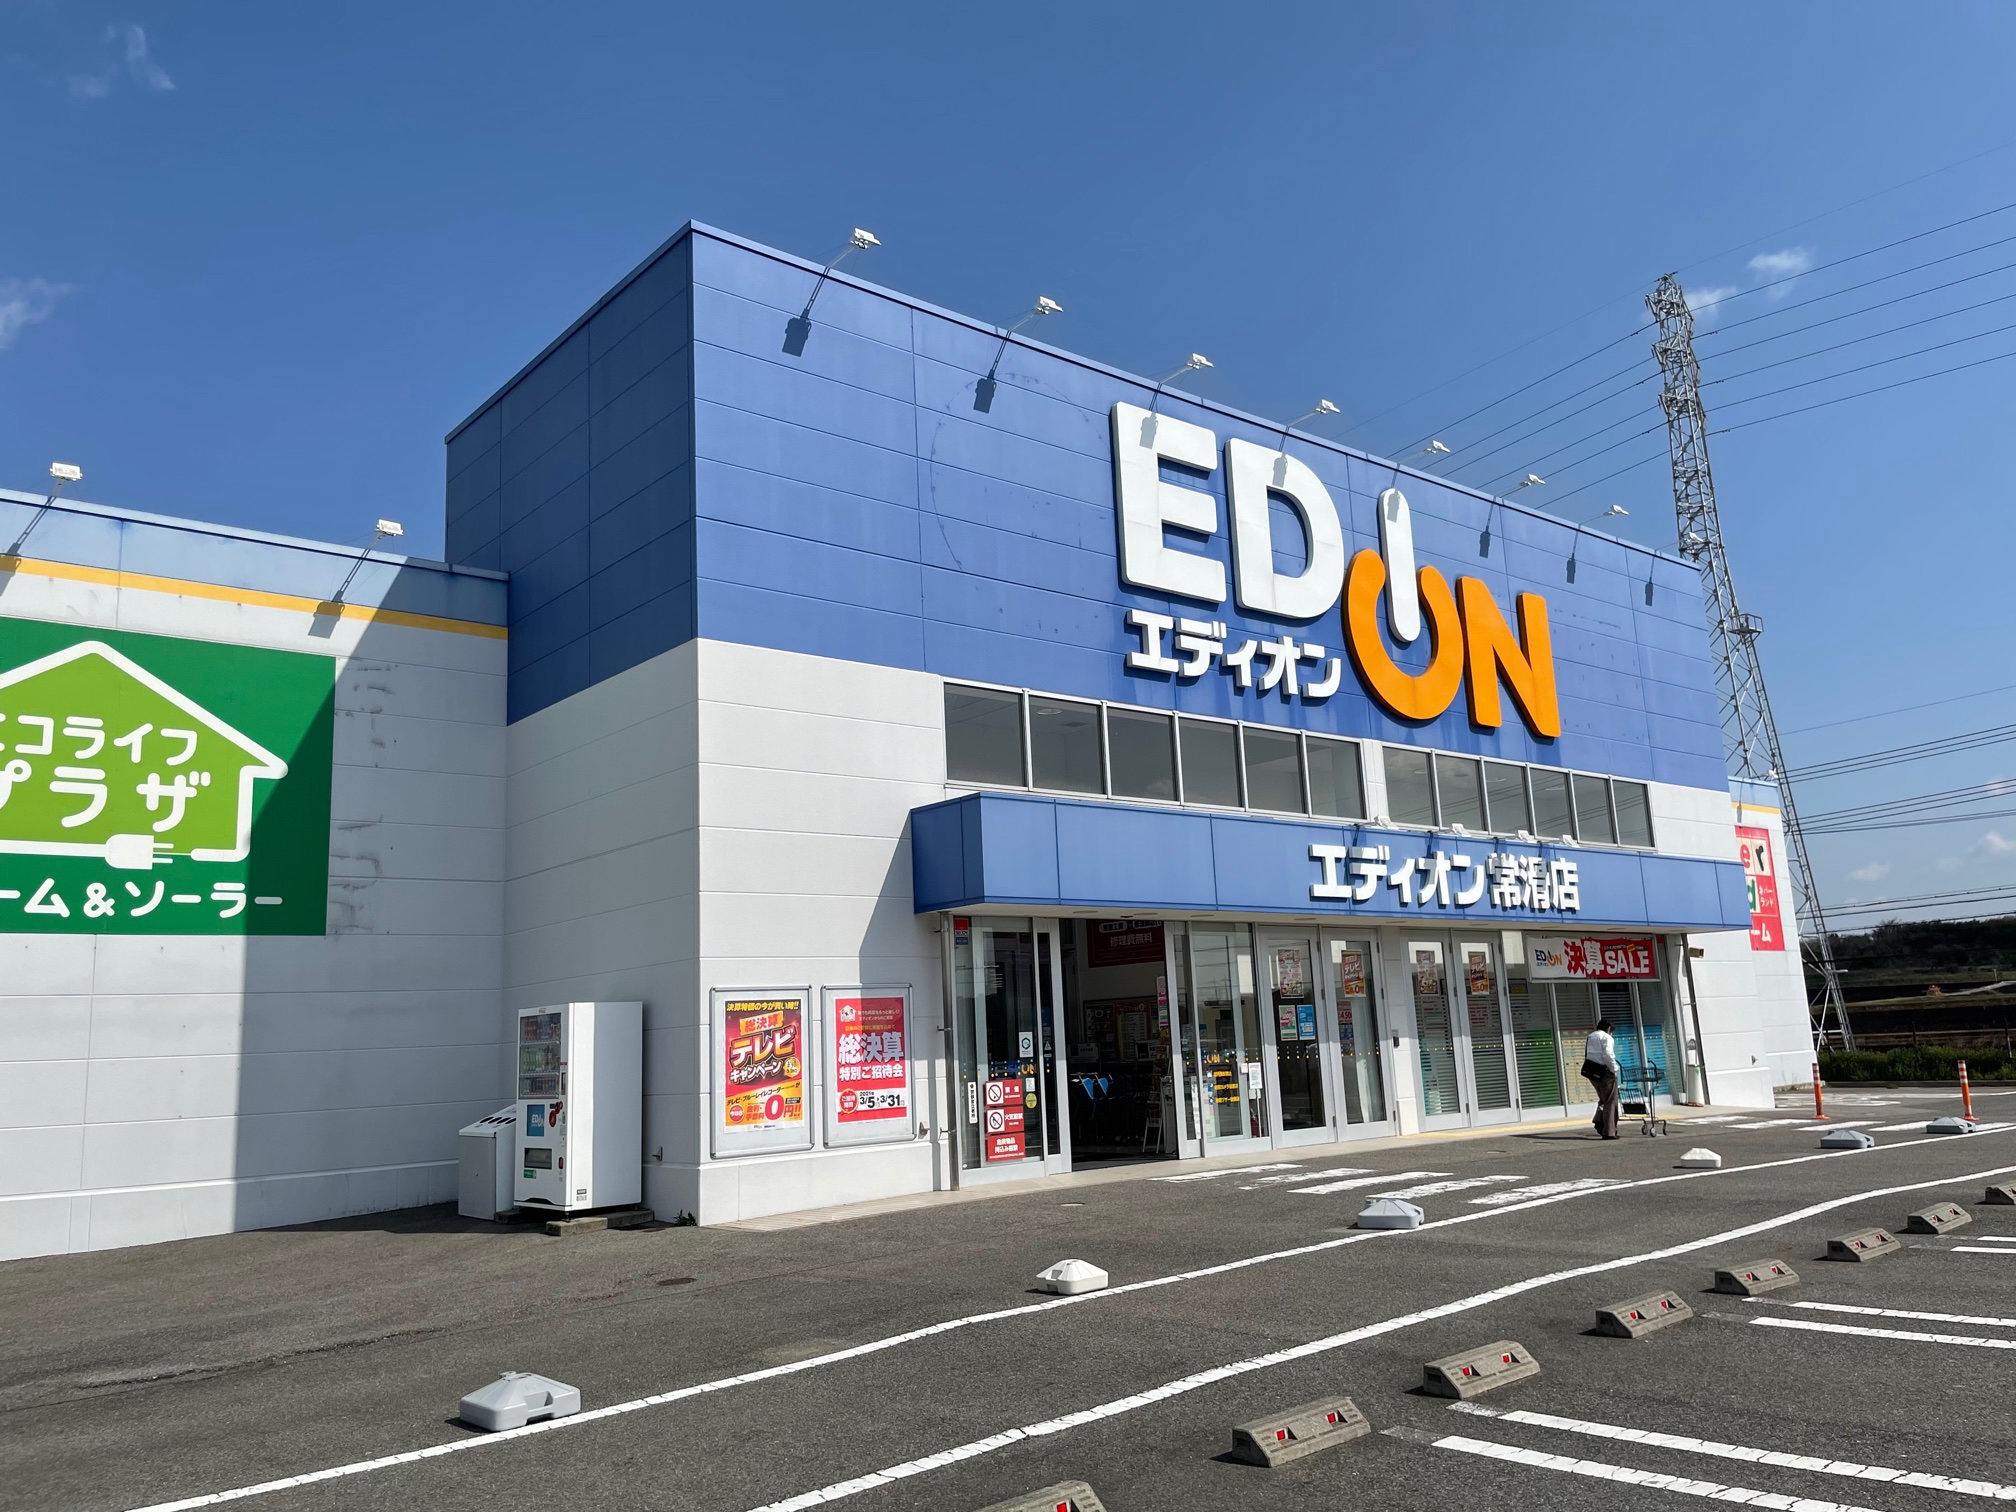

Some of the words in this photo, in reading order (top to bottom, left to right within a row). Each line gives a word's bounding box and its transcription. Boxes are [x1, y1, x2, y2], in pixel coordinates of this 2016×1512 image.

[1111, 401, 1561, 738] EDION
[1124, 608, 1342, 700] エディオン
[0, 713, 198, 766] コライフ
[1535, 949, 1563, 967] EDION
[731, 1027, 795, 1067] テレビ
[838, 1031, 905, 1065] 総決算
[730, 1060, 782, 1082] キャンペーン
[839, 1063, 904, 1082] 特別ご招待会
